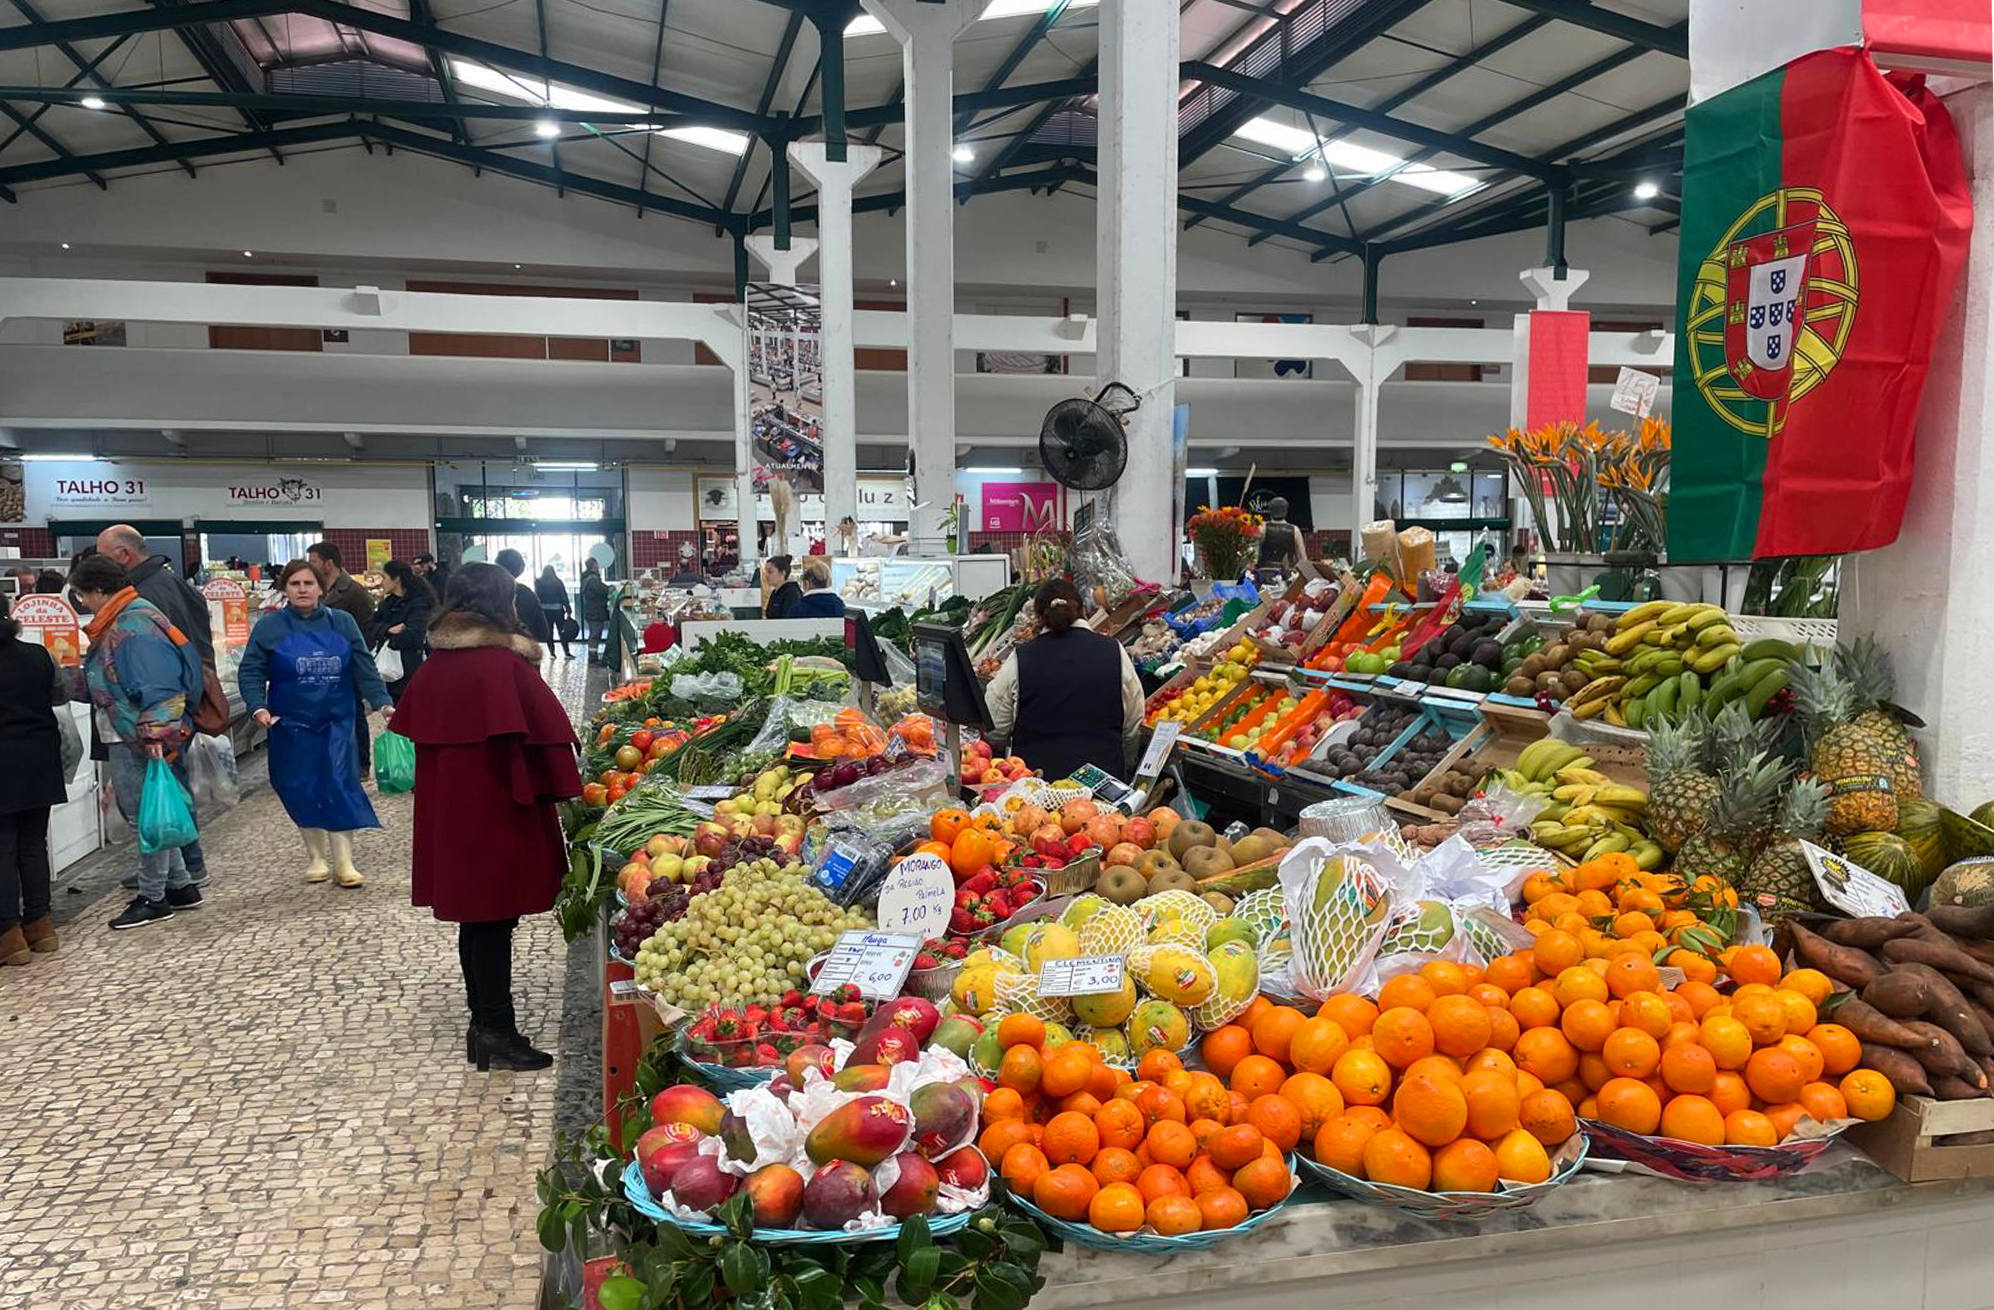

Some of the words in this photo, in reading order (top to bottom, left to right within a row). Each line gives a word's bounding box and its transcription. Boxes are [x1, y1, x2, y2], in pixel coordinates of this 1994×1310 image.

[56, 480, 119, 494] TALHO
[125, 480, 144, 494] 31
[228, 487, 279, 499] TALHO
[305, 488, 320, 499] 31
[18, 600, 63, 614] LOJINHA
[900, 859, 942, 876] MORANGO
[1088, 976, 1118, 986] 3,00
